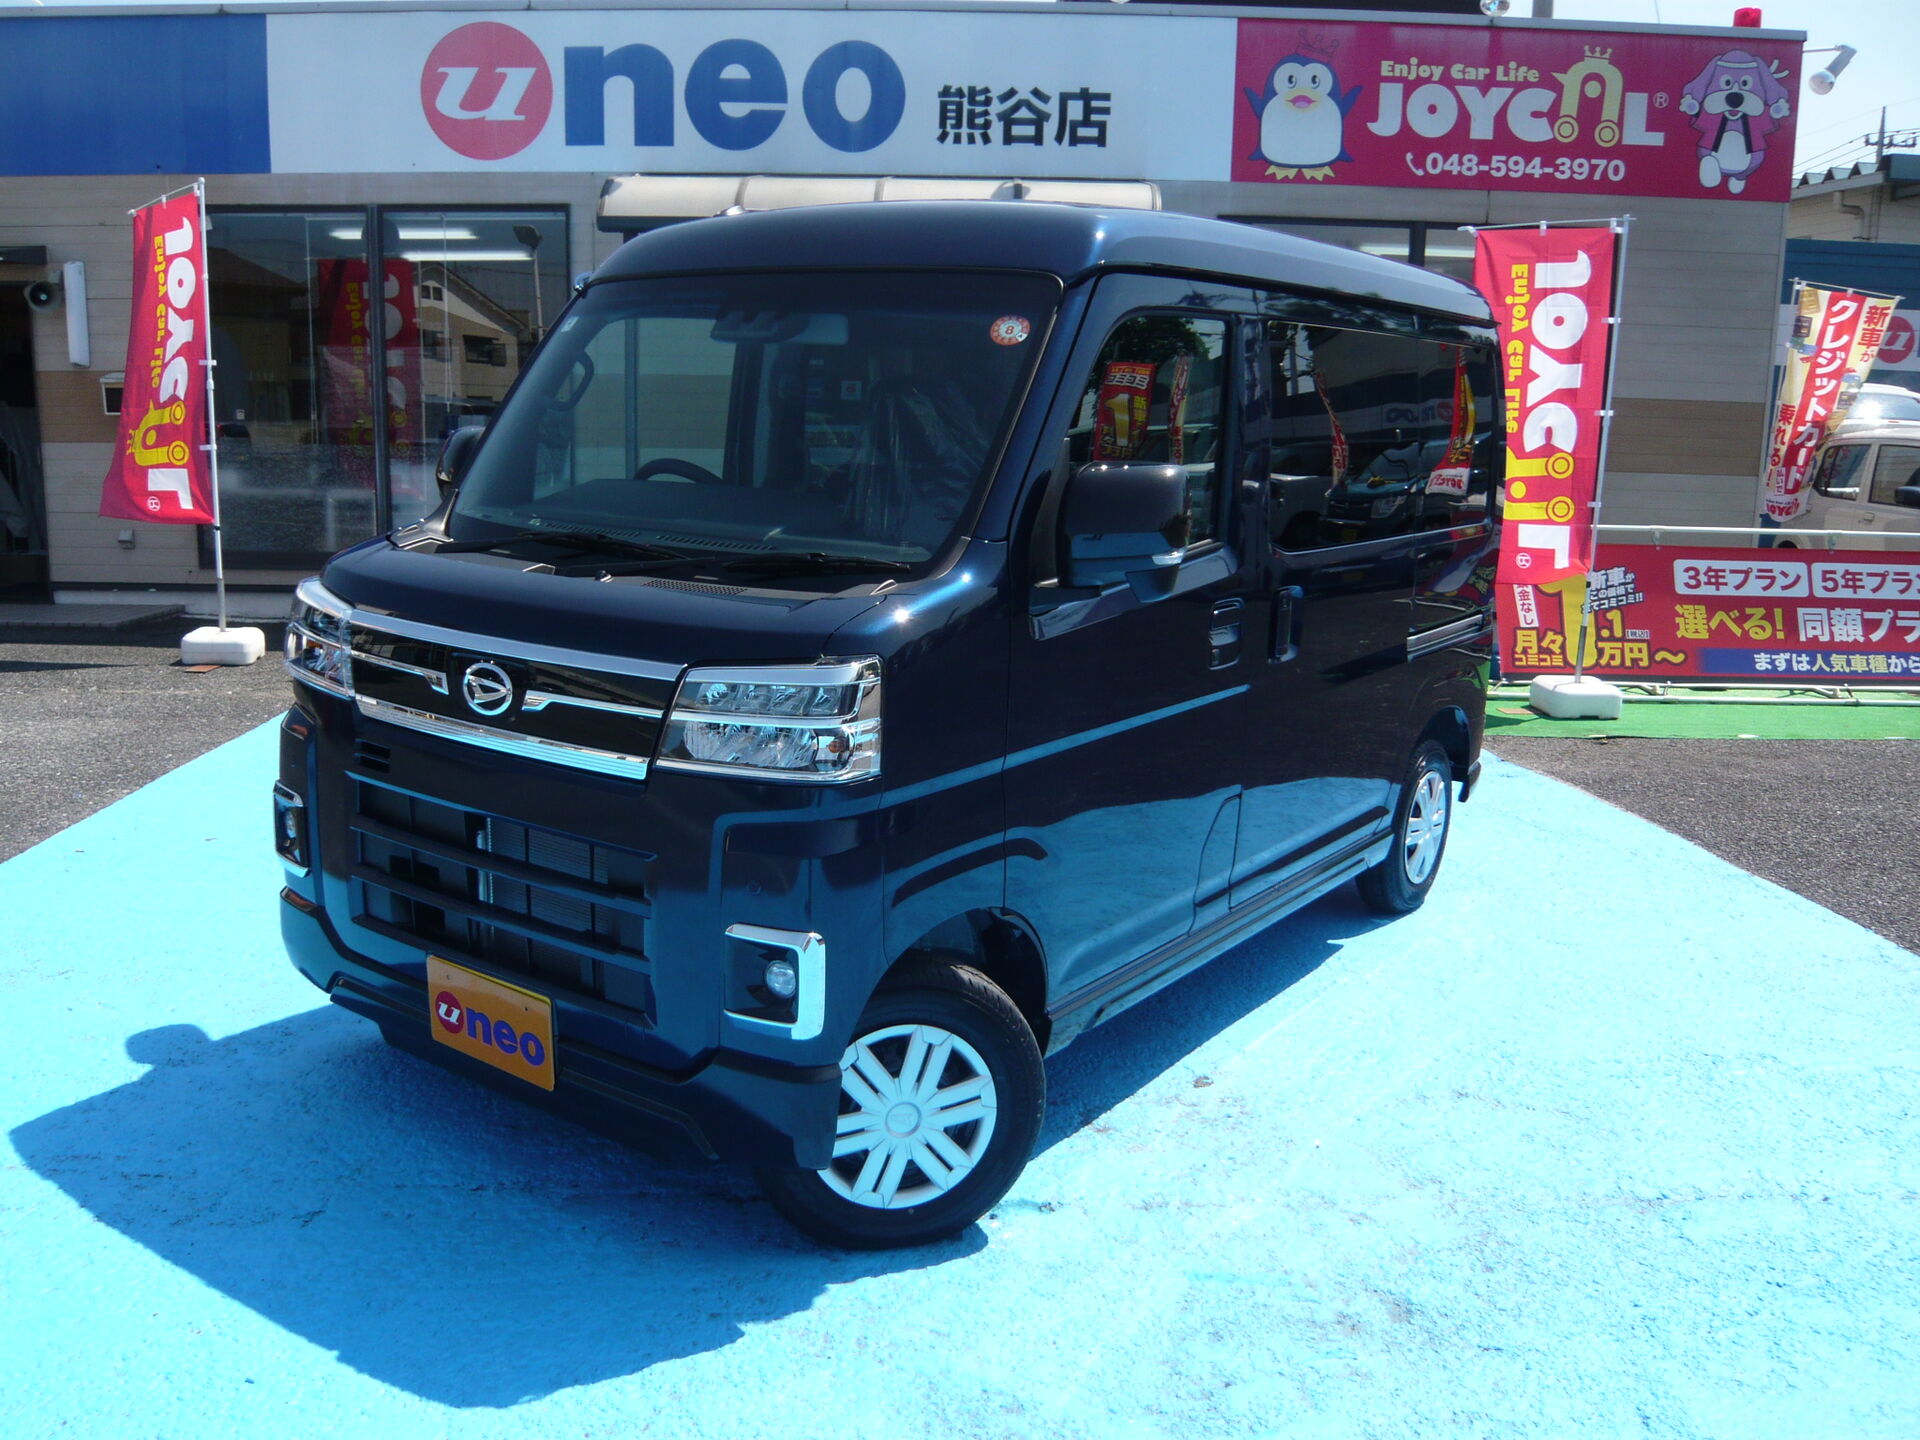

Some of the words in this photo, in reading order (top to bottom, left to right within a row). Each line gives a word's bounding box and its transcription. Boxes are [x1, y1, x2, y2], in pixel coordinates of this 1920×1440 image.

[1380, 60, 1446, 84] Enjoy
[1450, 63, 1491, 82] Car
[1496, 62, 1540, 83] Life
[935, 84, 1113, 148] 熊谷店
[1366, 56, 1666, 148] JOYCAL
[1424, 151, 1627, 182] 048-594-3970
[1858, 304, 1892, 364] 新車が
[1786, 298, 1858, 490] クレジットカード
[1682, 565, 1802, 592] 3年プラン
[1820, 569, 1920, 595] 5年プラ
[1516, 584, 1535, 626] 金なし
[1674, 603, 1785, 640] 選べる!
[1796, 606, 1920, 643] 同額プラ
[1515, 629, 1566, 655] 月々
[1514, 653, 1565, 667] コミコミ
[1753, 651, 1920, 674] まずは人気車種から
